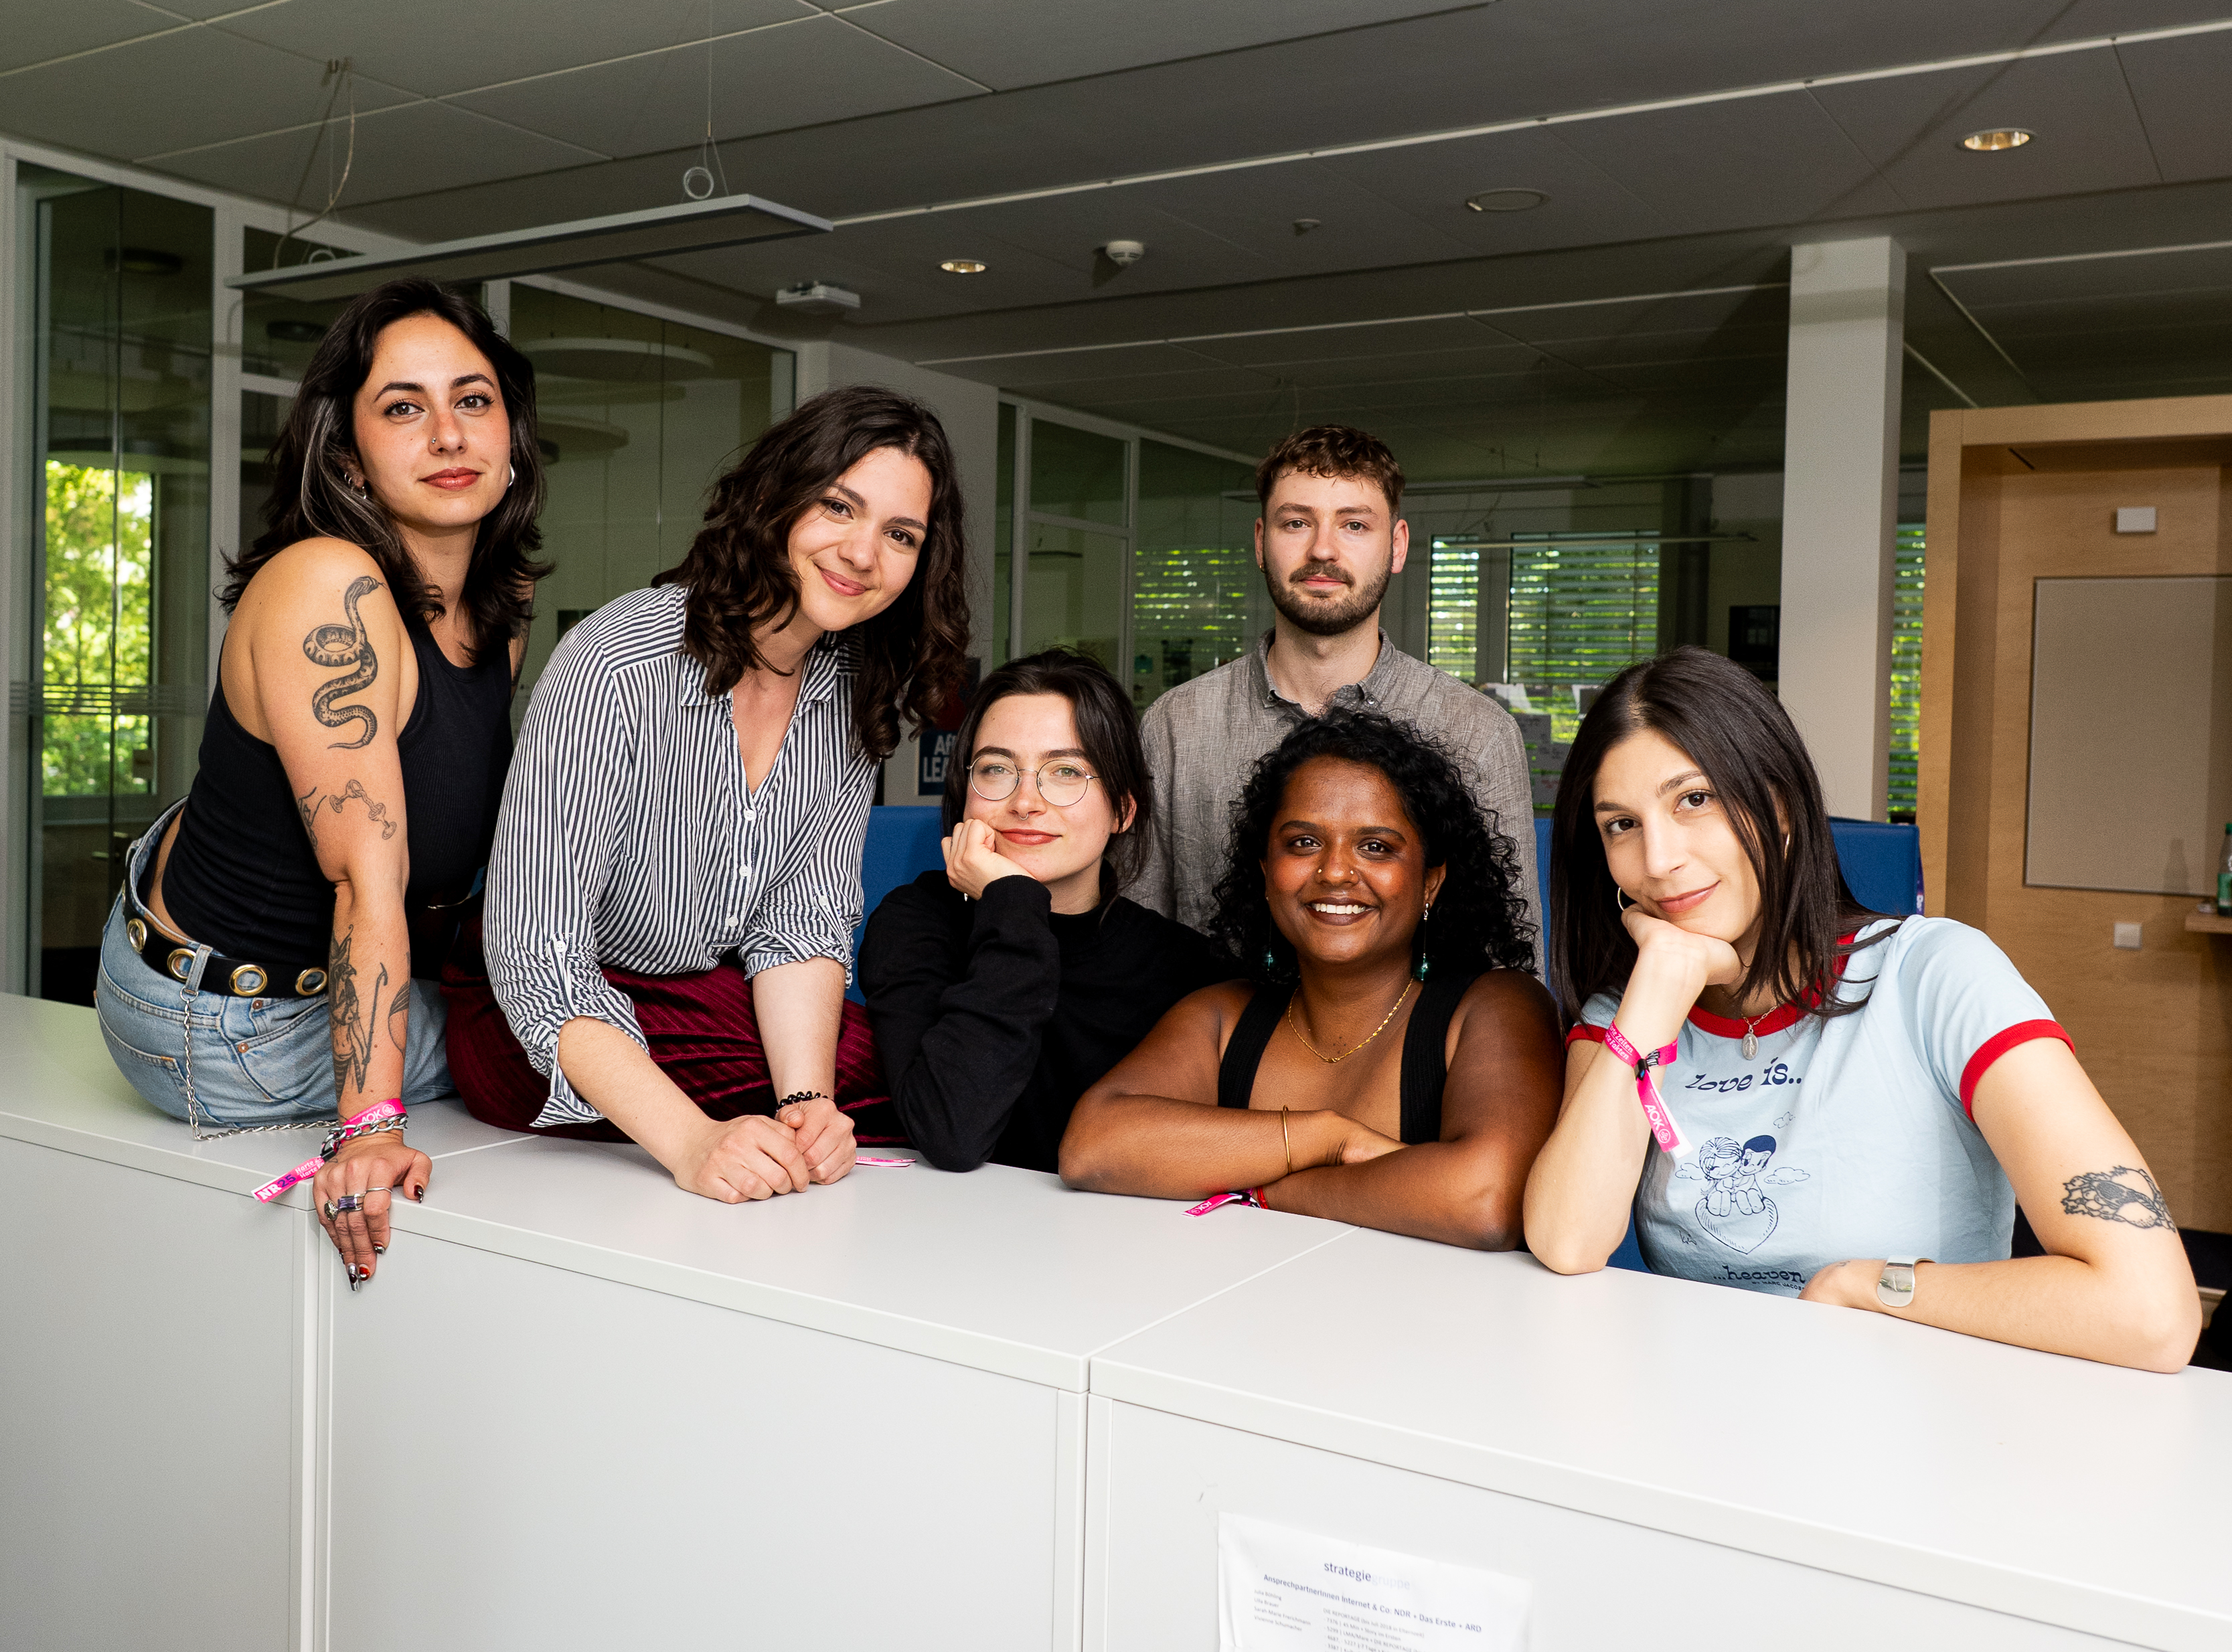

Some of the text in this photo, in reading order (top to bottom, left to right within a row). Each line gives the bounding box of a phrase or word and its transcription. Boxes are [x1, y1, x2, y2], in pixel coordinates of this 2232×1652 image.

[1609, 1040, 1629, 1060] Fakten
[1615, 1034, 1633, 1053] Zeiten
[1685, 1074, 1753, 1092] love
[362, 1109, 384, 1123] AOK
[1644, 1104, 1665, 1131] AOK
[295, 1161, 314, 1173] Harte
[300, 1167, 317, 1178] Harte
[257, 1175, 296, 1200] NR25
[1264, 1574, 1340, 1600] AnsprechpartnerInnen
[1342, 1595, 1370, 1609] Internet
[1394, 1608, 1411, 1619] NDR
[1419, 1614, 1433, 1624] Das
[1435, 1618, 1456, 1629] Erste
[1465, 1623, 1482, 1633] ARD
